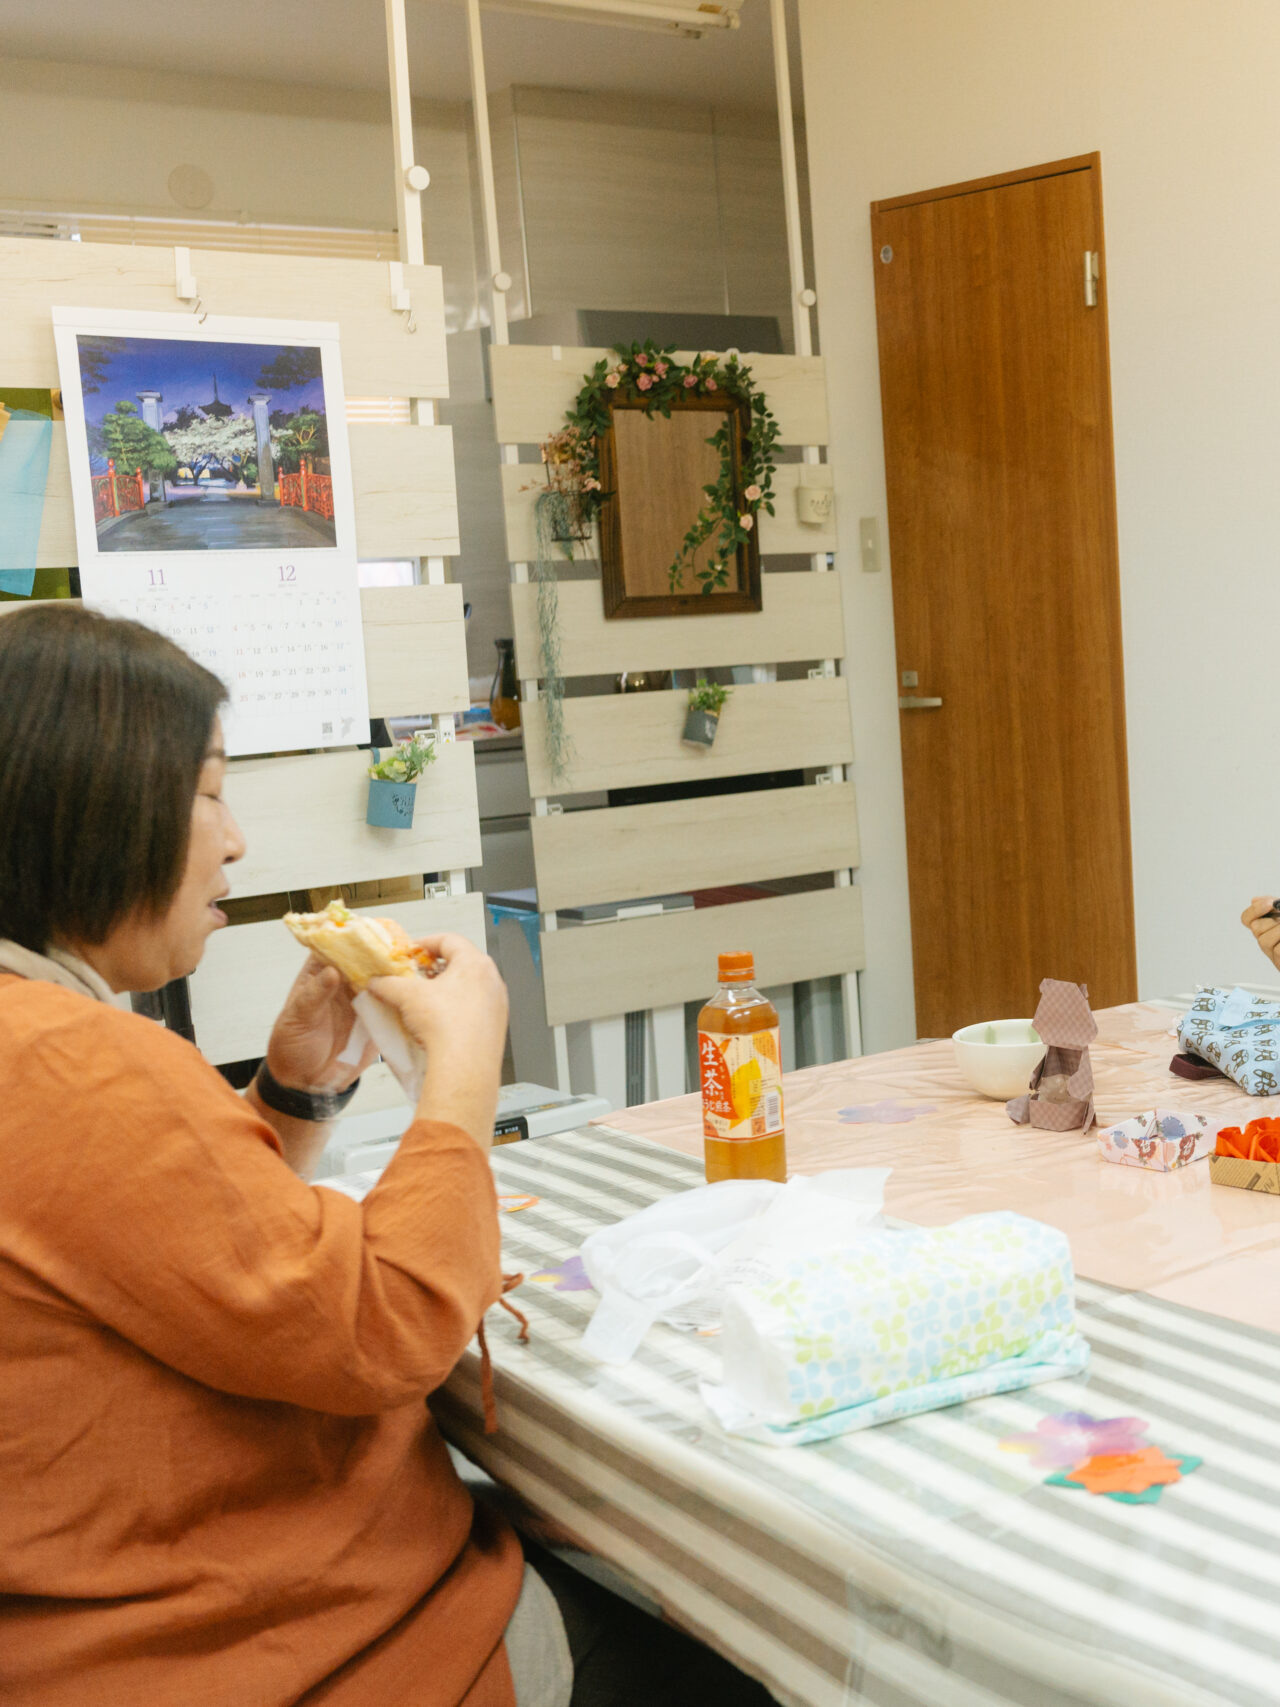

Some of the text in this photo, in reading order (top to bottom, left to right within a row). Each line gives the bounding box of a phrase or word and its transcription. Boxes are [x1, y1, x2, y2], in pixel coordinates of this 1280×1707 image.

[148, 569, 166, 586] 11
[278, 565, 297, 582] 12
[702, 1040, 723, 1096] 生茶
[702, 1097, 732, 1113] うじ煎茶
